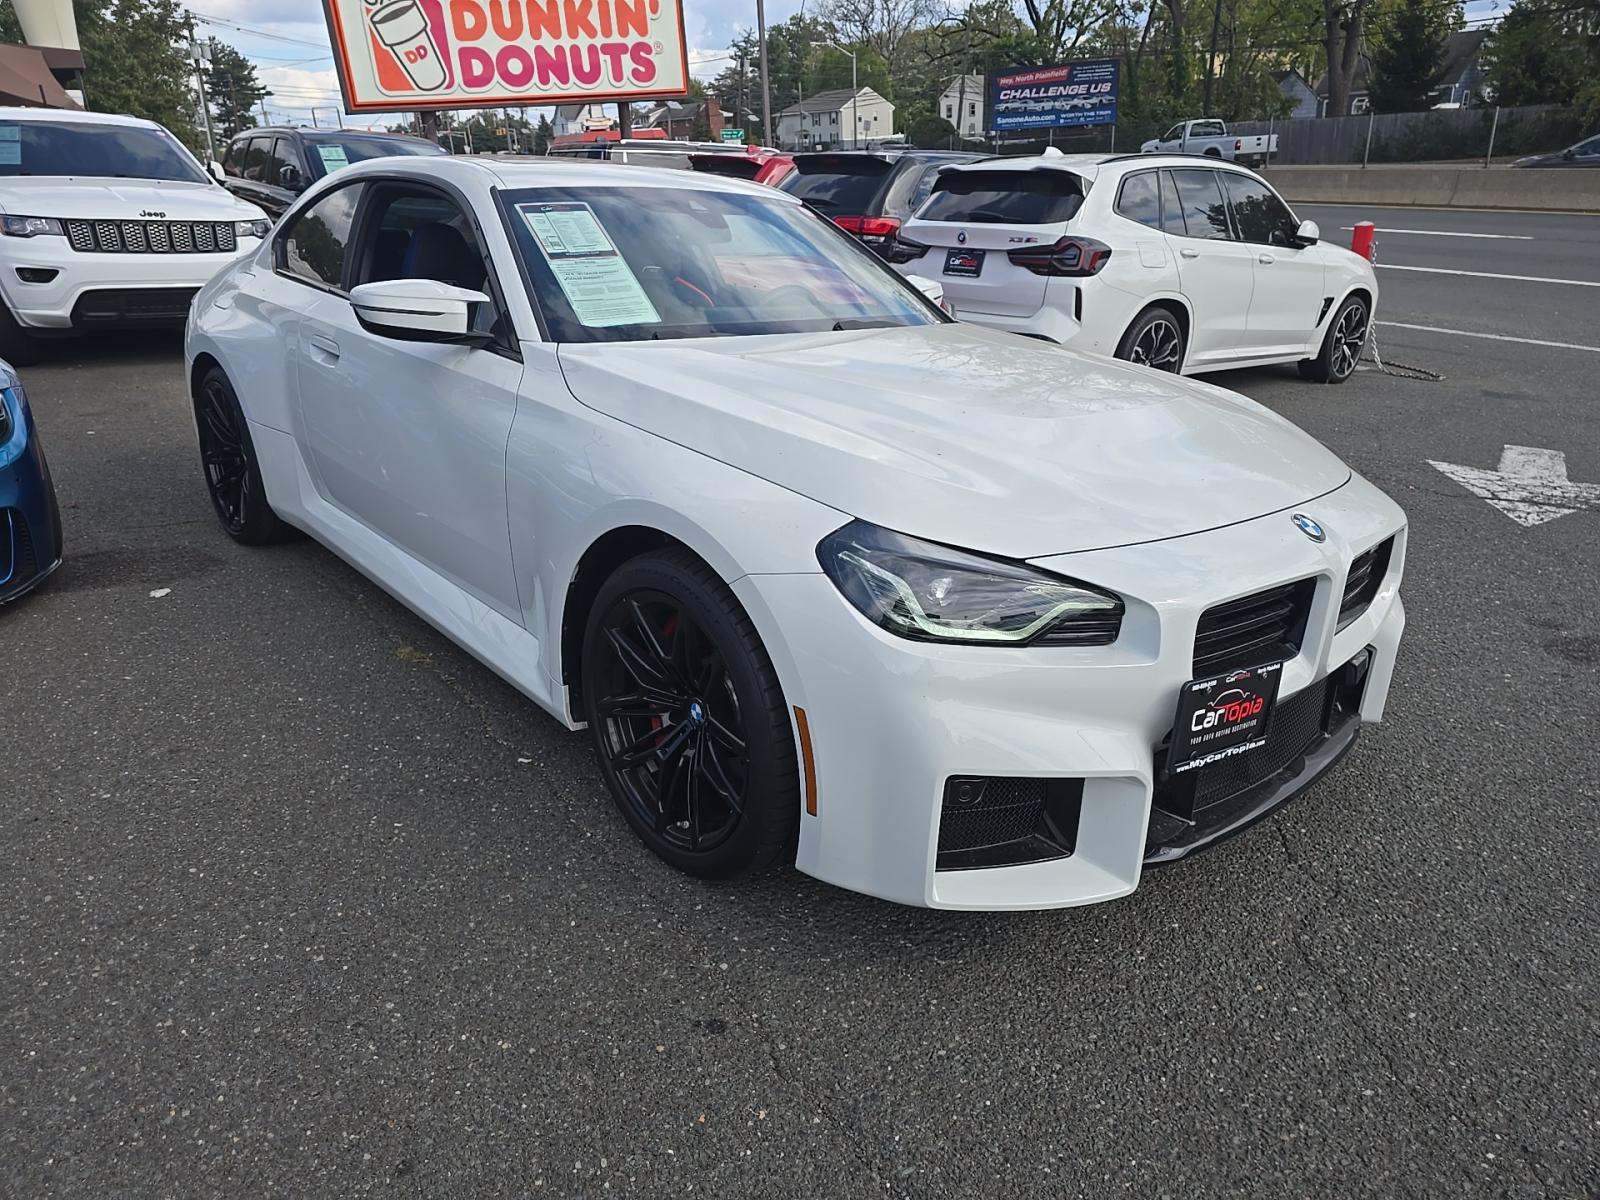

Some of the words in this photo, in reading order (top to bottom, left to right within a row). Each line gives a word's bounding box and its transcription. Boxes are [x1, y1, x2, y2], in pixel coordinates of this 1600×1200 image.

[449, 0, 659, 41] DUNKIN'
[404, 44, 428, 64] DD
[457, 42, 656, 88] DONUTS
[1015, 74, 1034, 82] North
[1000, 85, 1086, 99] CHALLENGE
[1090, 82, 1112, 93] US
[139, 210, 166, 218] Jeep
[1191, 696, 1264, 731] CarTopia
